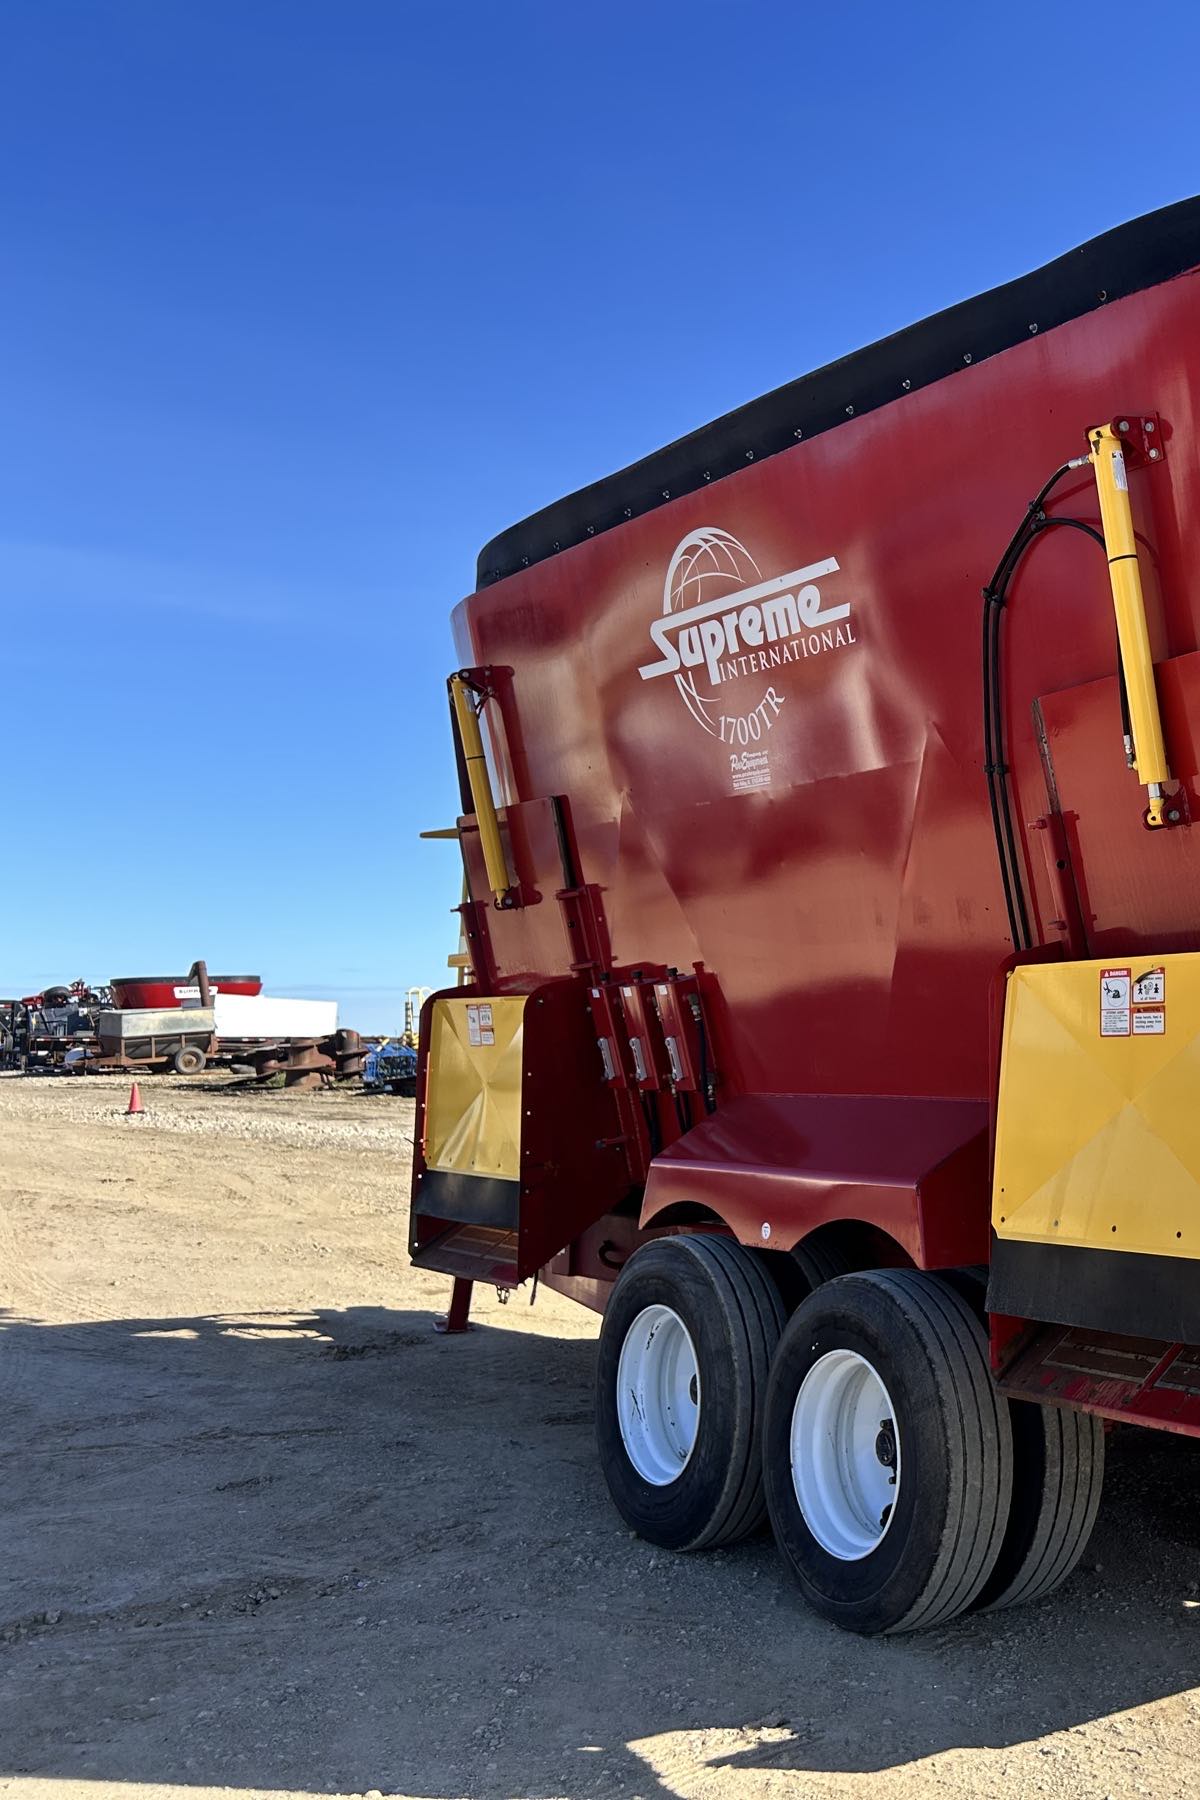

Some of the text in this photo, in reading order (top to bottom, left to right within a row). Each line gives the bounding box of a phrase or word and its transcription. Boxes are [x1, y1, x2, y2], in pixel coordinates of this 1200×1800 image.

[638, 556, 851, 686] Supreme
[719, 623, 856, 682] INTERNATIONAL
[718, 686, 786, 745] 1700TR
